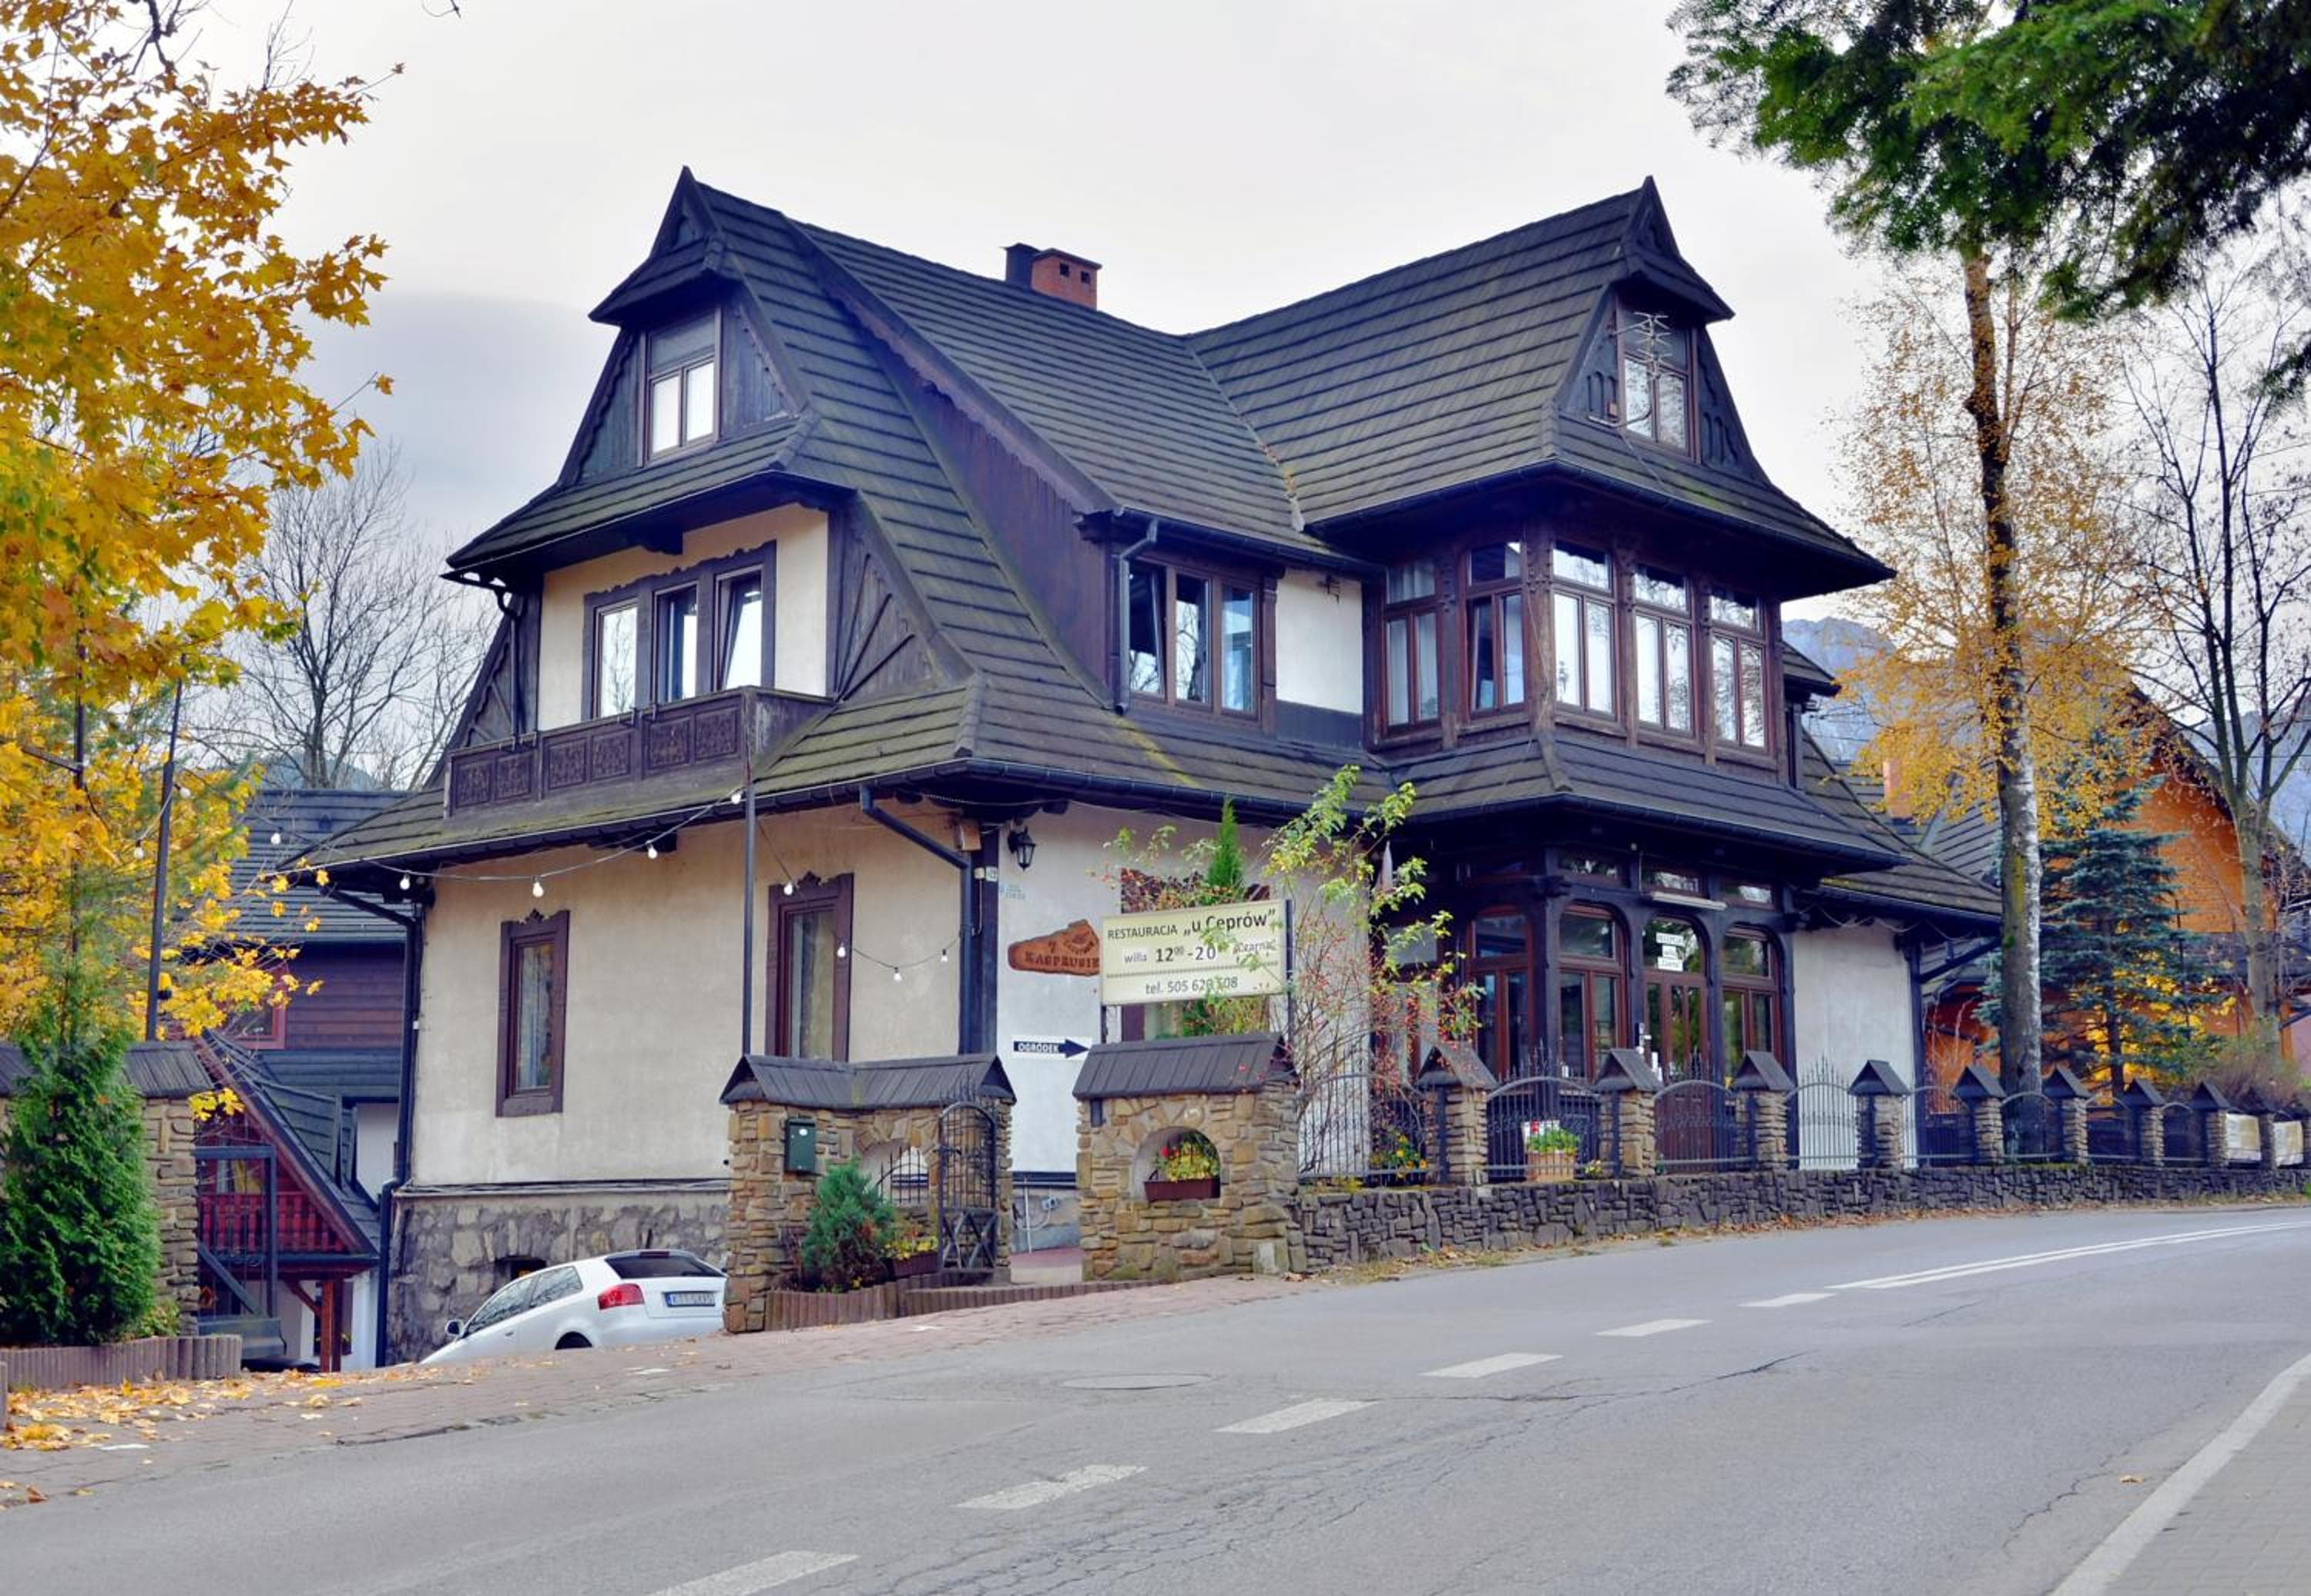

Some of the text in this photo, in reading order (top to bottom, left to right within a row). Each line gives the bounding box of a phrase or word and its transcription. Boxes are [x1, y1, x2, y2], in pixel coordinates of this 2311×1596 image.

[1107, 924, 1178, 940] RESTAURACJA
[1124, 951, 1147, 963] willa
[1145, 981, 1163, 994] tel.
[1167, 980, 1189, 993] 505
